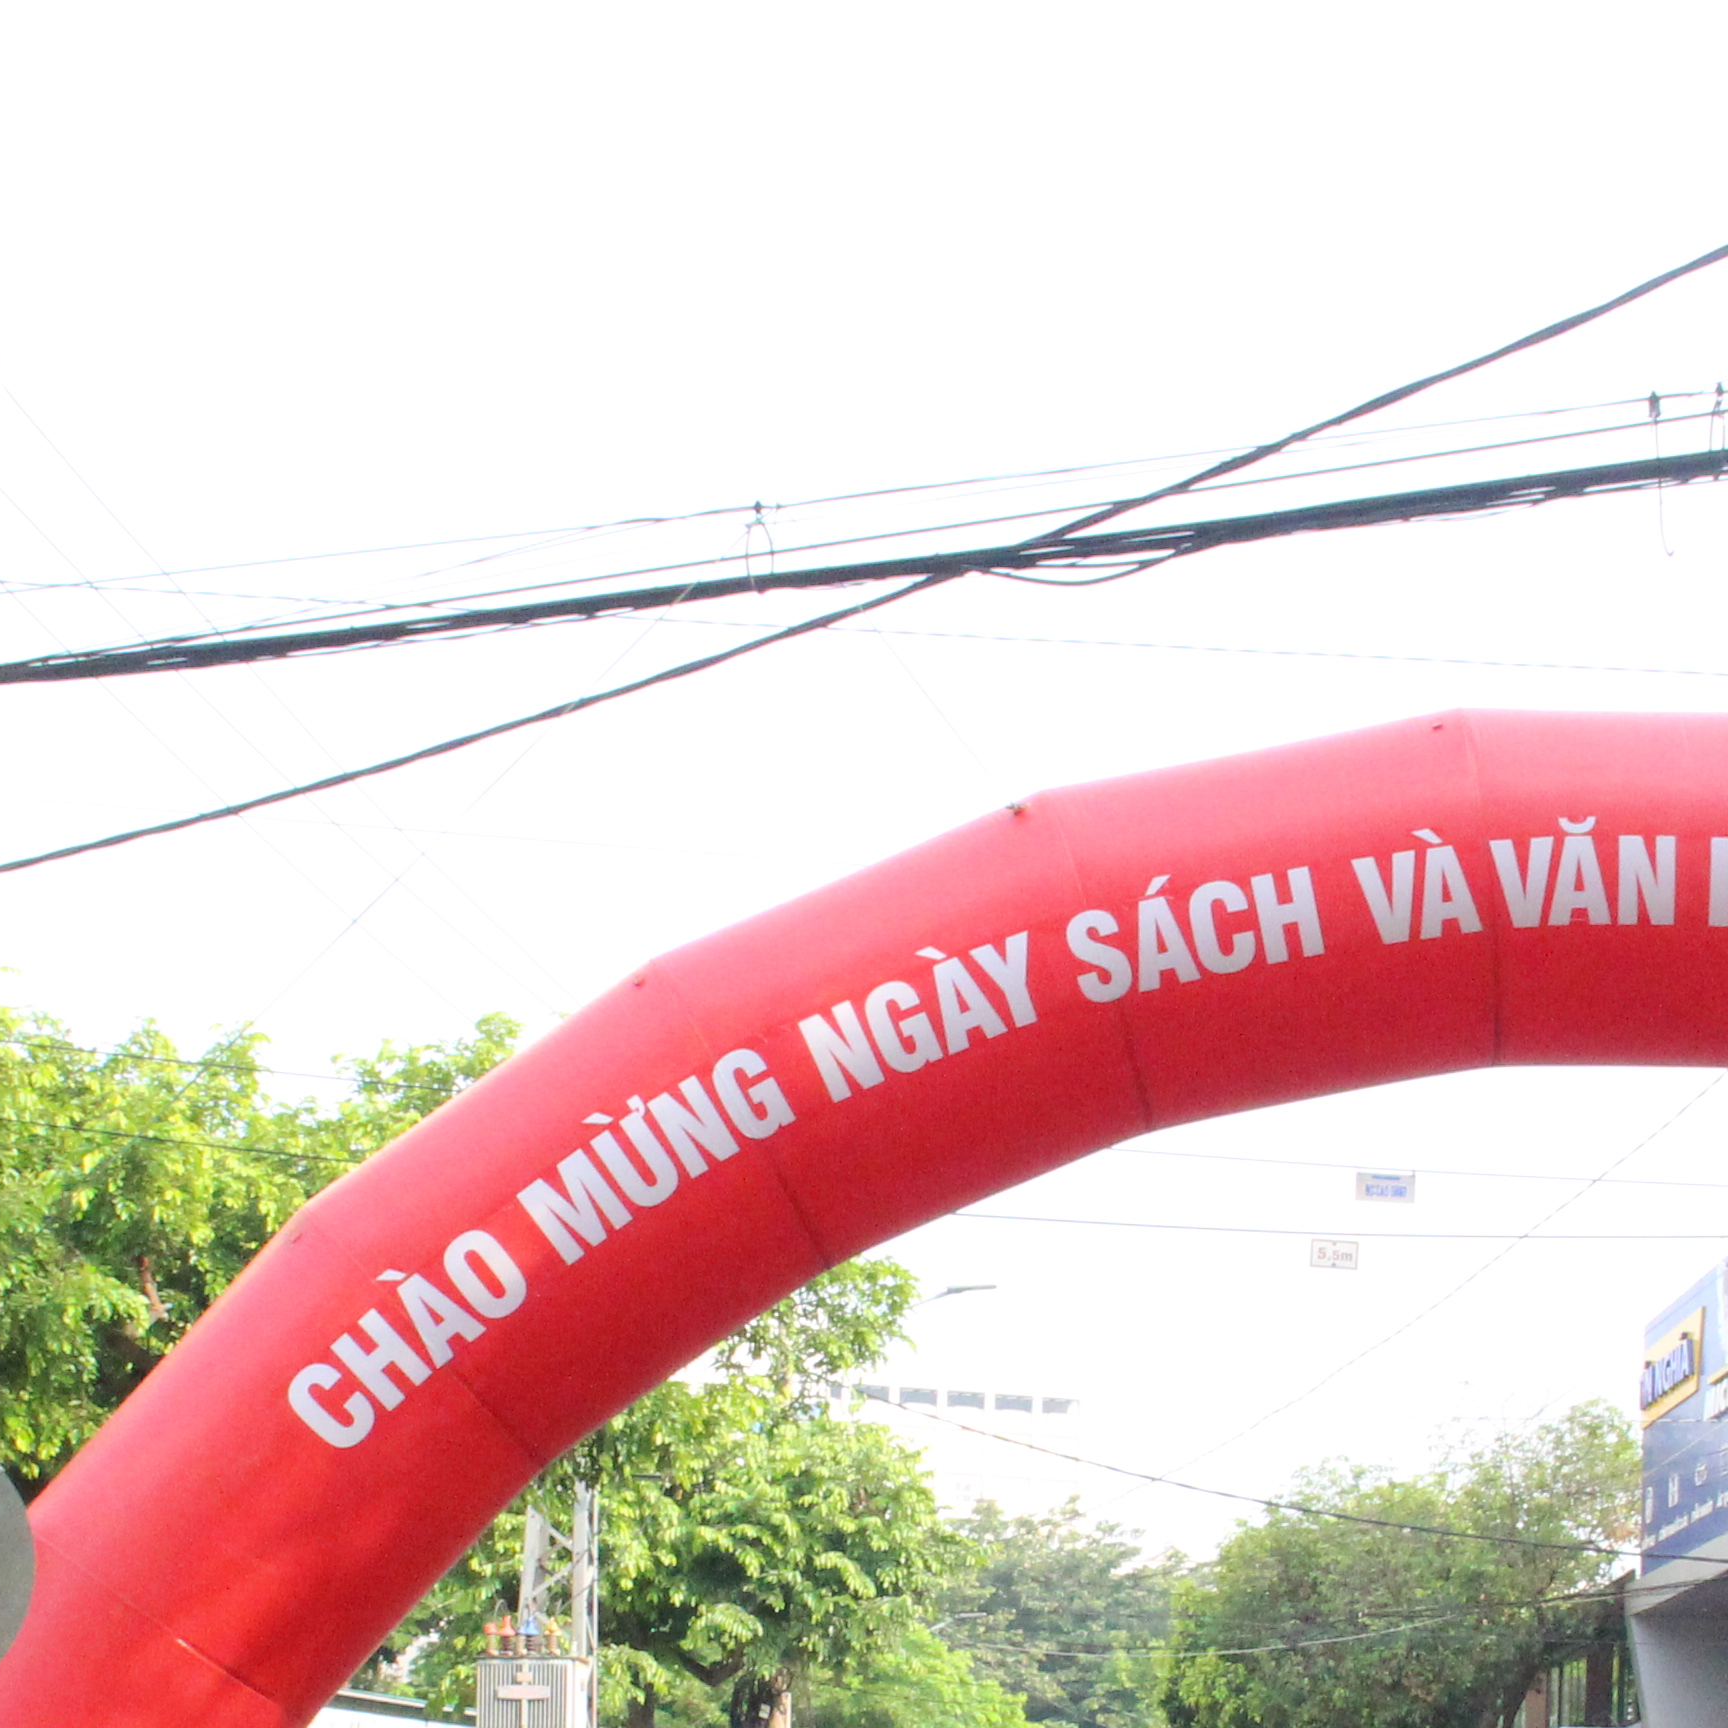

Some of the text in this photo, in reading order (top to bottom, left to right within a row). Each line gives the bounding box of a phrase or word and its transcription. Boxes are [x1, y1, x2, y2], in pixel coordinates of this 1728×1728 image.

[286, 1229, 527, 1448] CHÀO
[515, 1048, 795, 1265] MỪNG
[805, 931, 1039, 1102] NGÀY
[1066, 867, 1324, 1002] SÁCH
[1350, 829, 1481, 945] VÀ
[1488, 816, 1674, 929] VĂN
